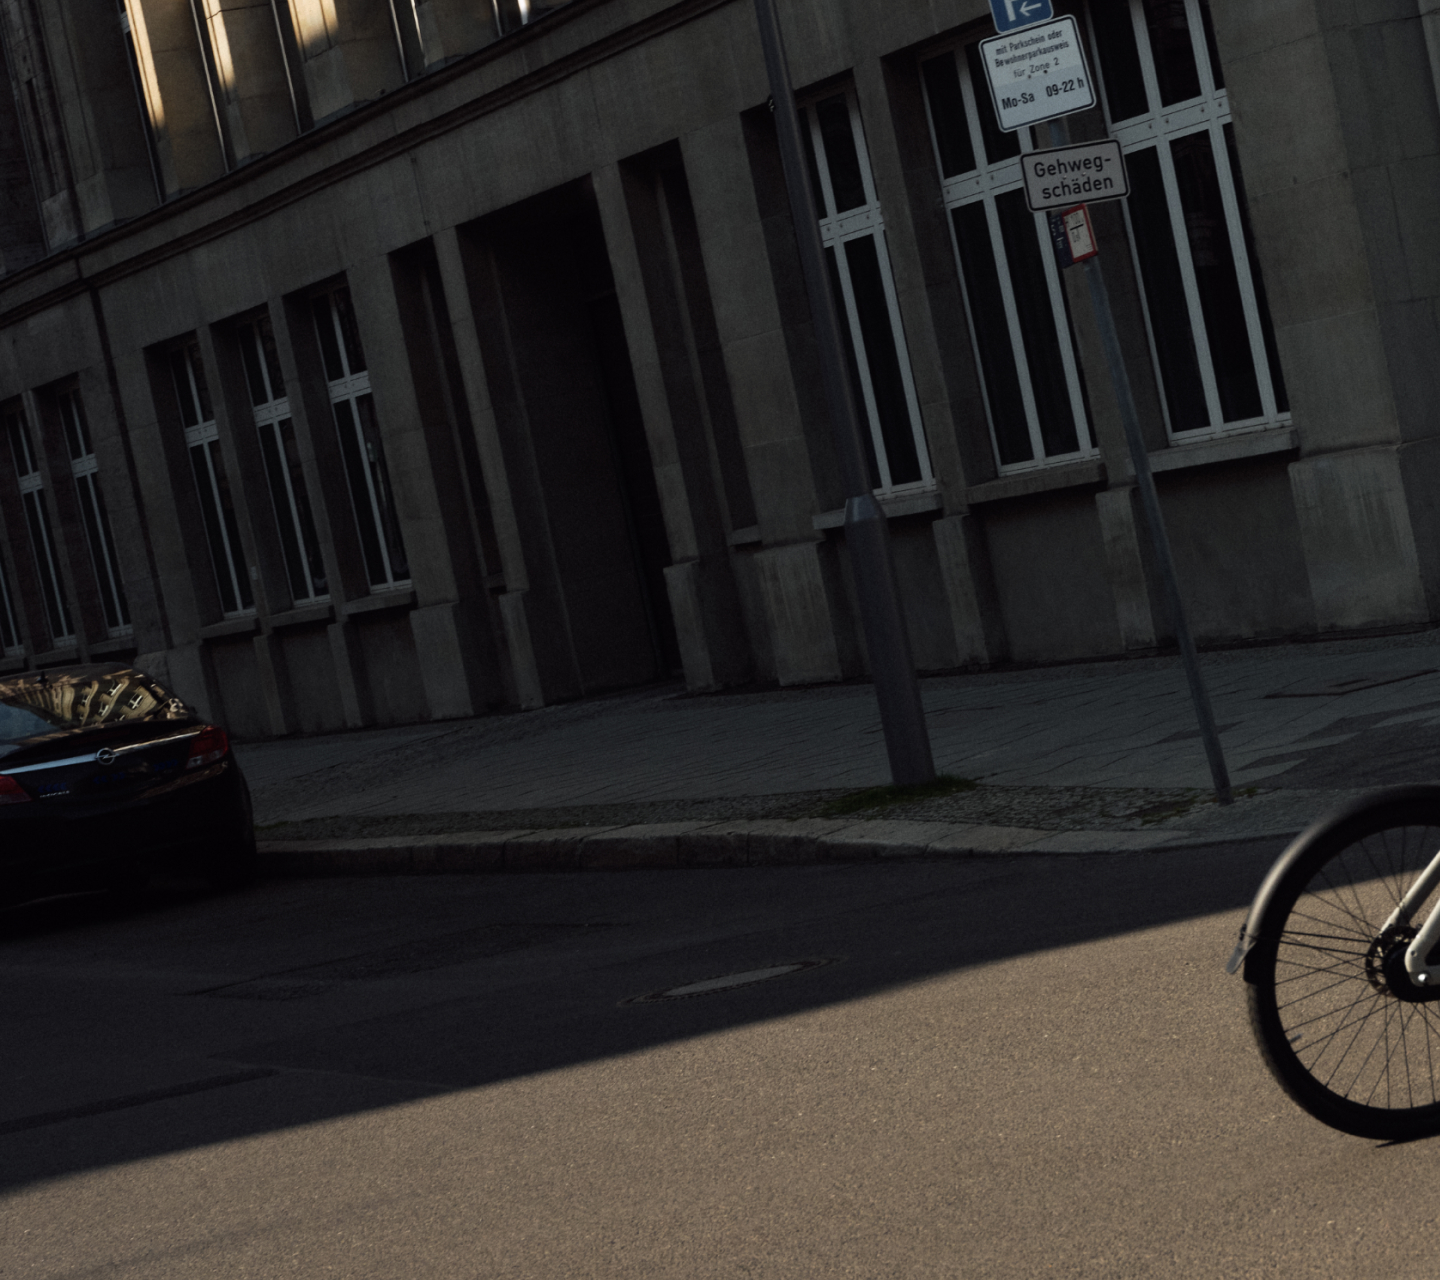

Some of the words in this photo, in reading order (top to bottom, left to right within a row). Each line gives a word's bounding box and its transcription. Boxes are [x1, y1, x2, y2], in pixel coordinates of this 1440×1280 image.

[994, 40, 1070, 68] Bewohnerparkausweis
[995, 44, 1008, 56] mit
[1009, 34, 1046, 52] Parkschein
[1047, 29, 1063, 41] oder
[1013, 67, 1026, 78] für
[1029, 61, 1050, 74] Zone
[1053, 57, 1060, 66] 2
[1001, 92, 1036, 110] Mo-Sa
[1045, 79, 1076, 98] 09-22
[1076, 77, 1085, 89] h
[1034, 156, 1112, 178] Gehweg-
[1042, 176, 1114, 200] schäden
